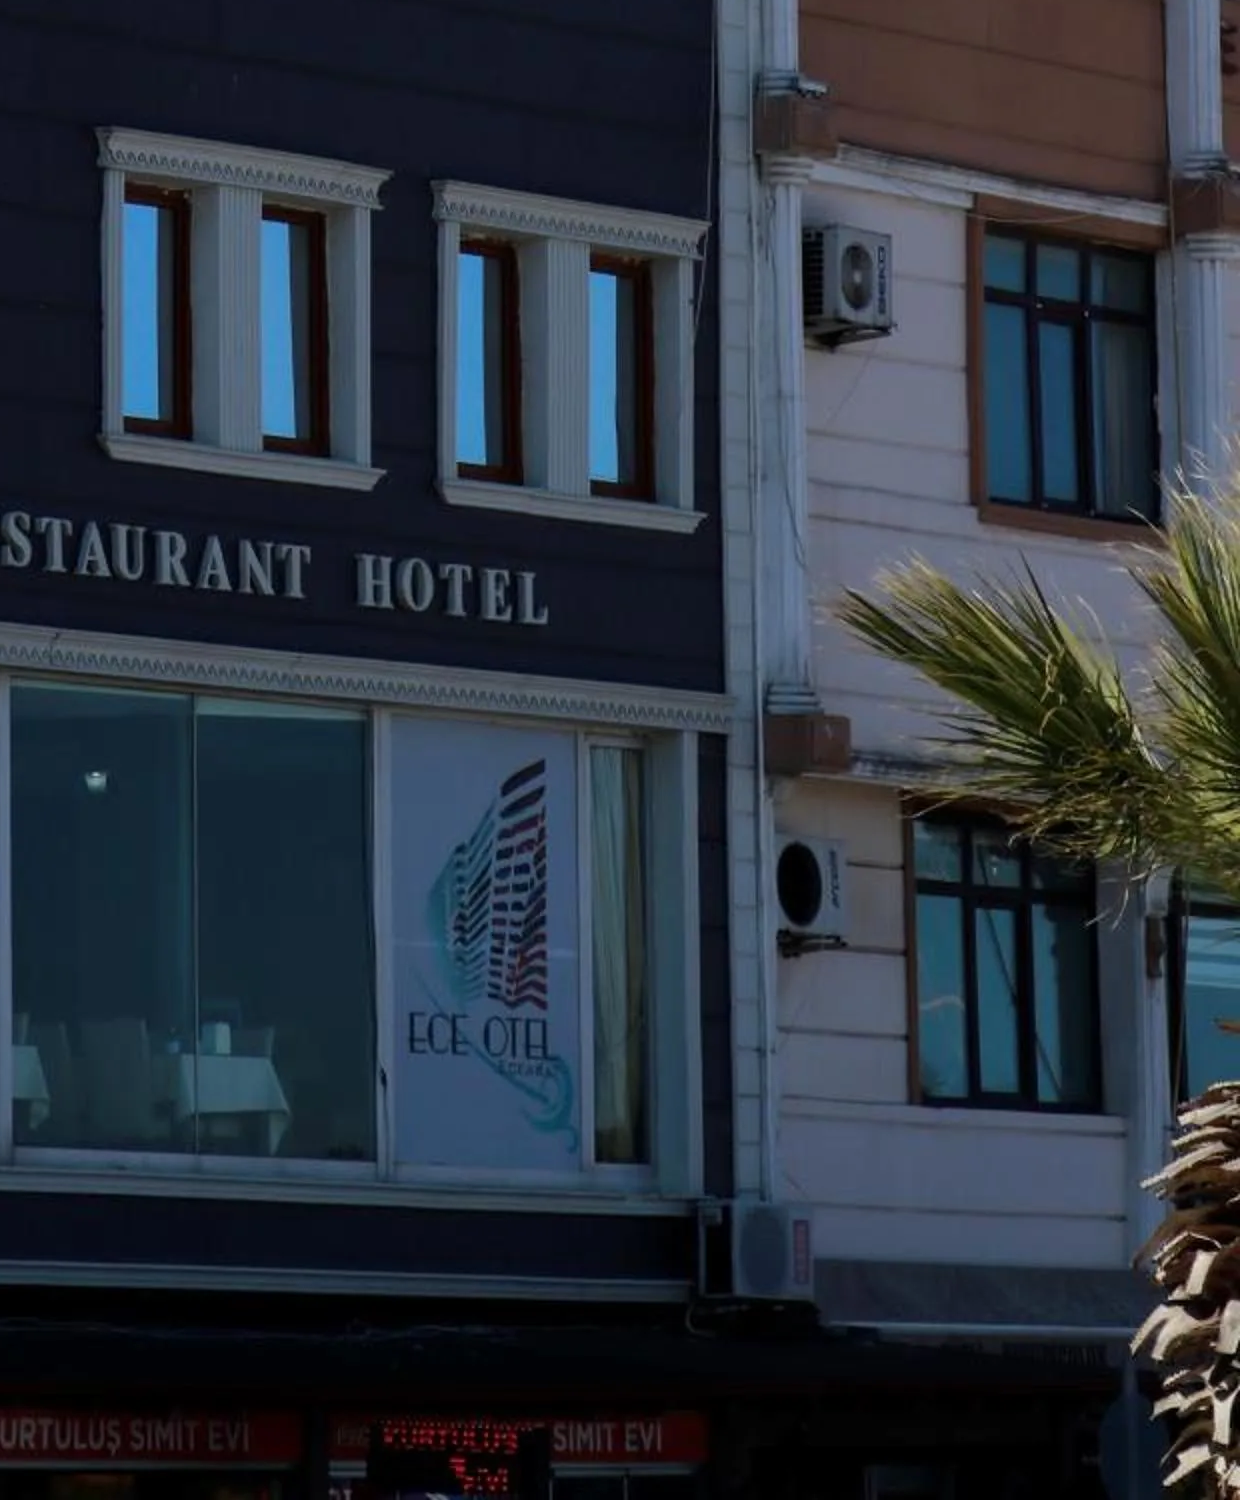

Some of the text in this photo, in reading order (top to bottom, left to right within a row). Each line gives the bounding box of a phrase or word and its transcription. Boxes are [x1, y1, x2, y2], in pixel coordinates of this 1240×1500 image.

[354, 552, 550, 626] HOTEL
[408, 1012, 560, 1061] ECE OTEL
